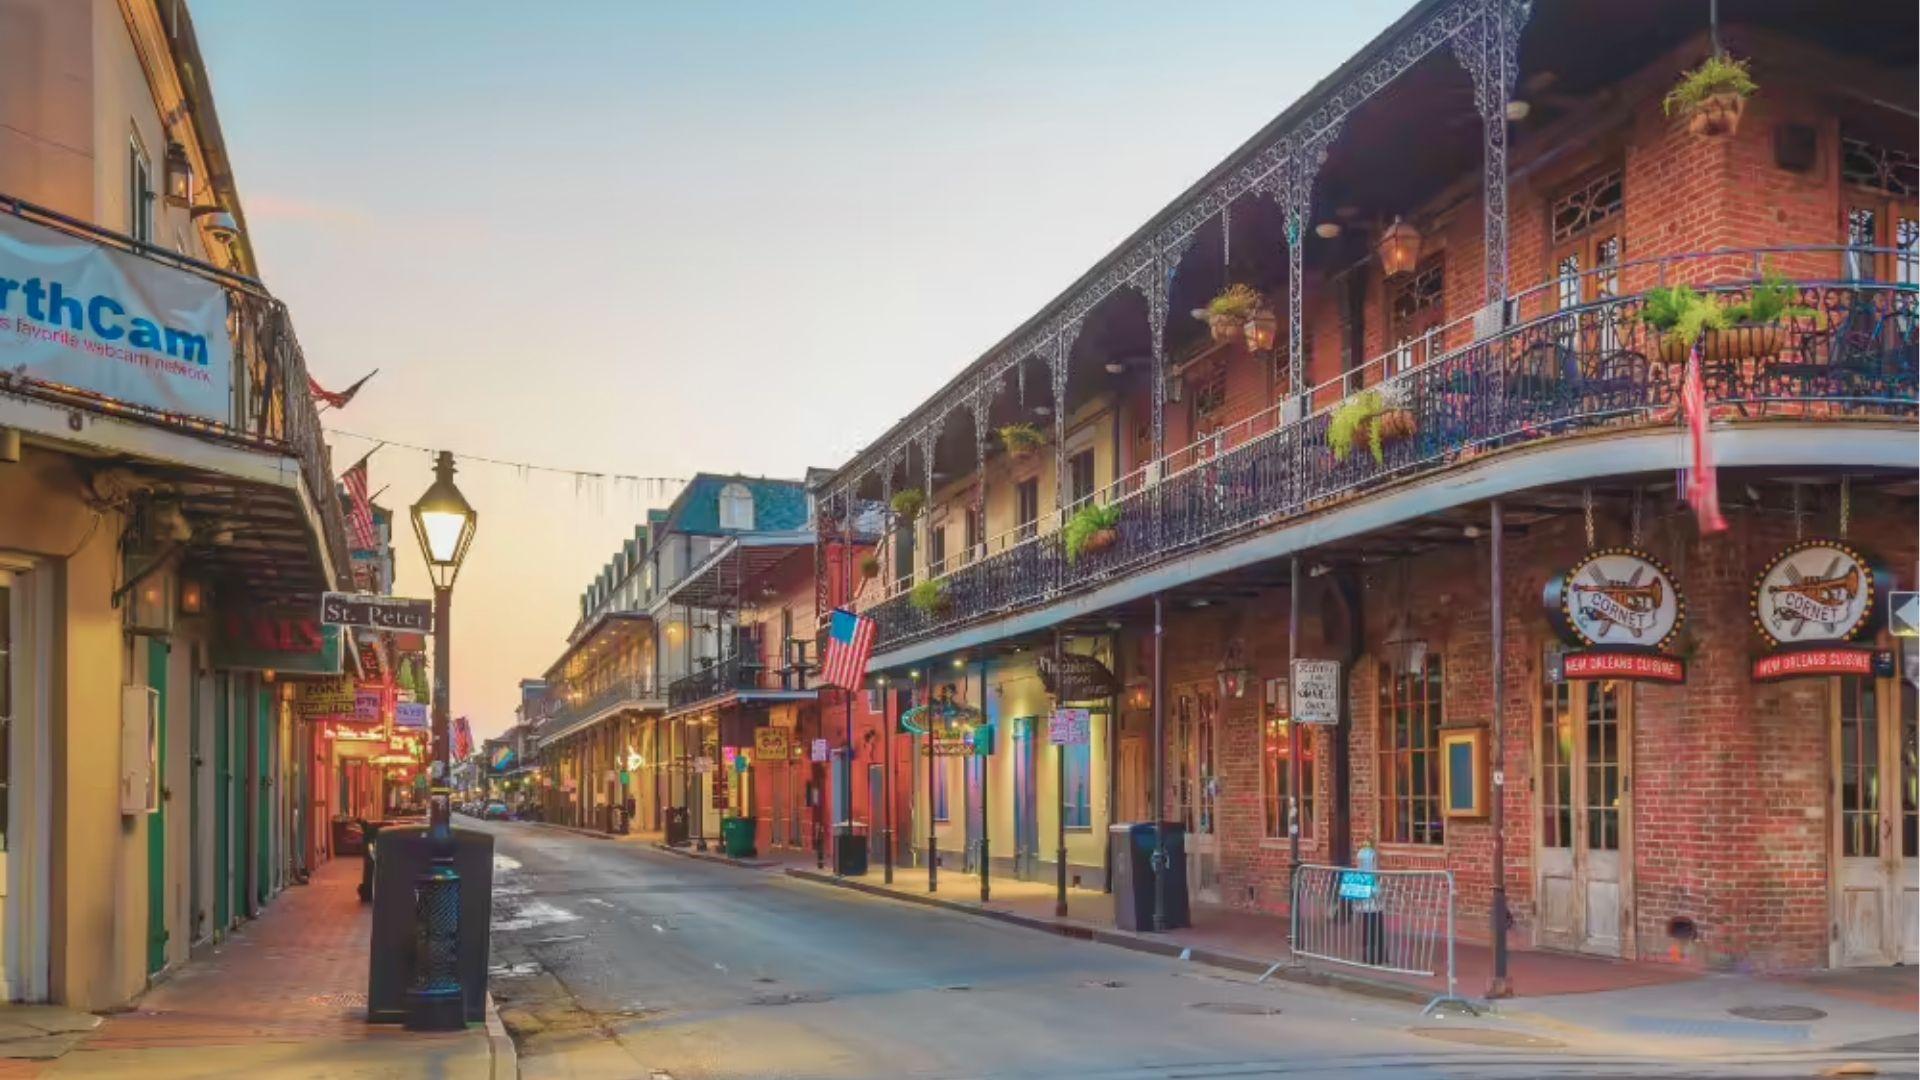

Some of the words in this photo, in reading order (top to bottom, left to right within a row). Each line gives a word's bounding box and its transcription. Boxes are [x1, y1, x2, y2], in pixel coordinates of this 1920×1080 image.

[17, 317, 79, 349] favorite
[84, 337, 150, 367] webcam
[155, 356, 212, 383] network
[327, 604, 357, 621] St.
[1591, 592, 1646, 628] CORNET
[1785, 593, 1840, 622] CORNET
[1566, 658, 1586, 671] NEW
[1591, 656, 1632, 670] ORLEANS
[1637, 658, 1675, 674] CUISINE
[1760, 659, 1780, 673] NEW
[1783, 654, 1826, 670] ORLEANS
[1830, 653, 1870, 667] CUISINE
